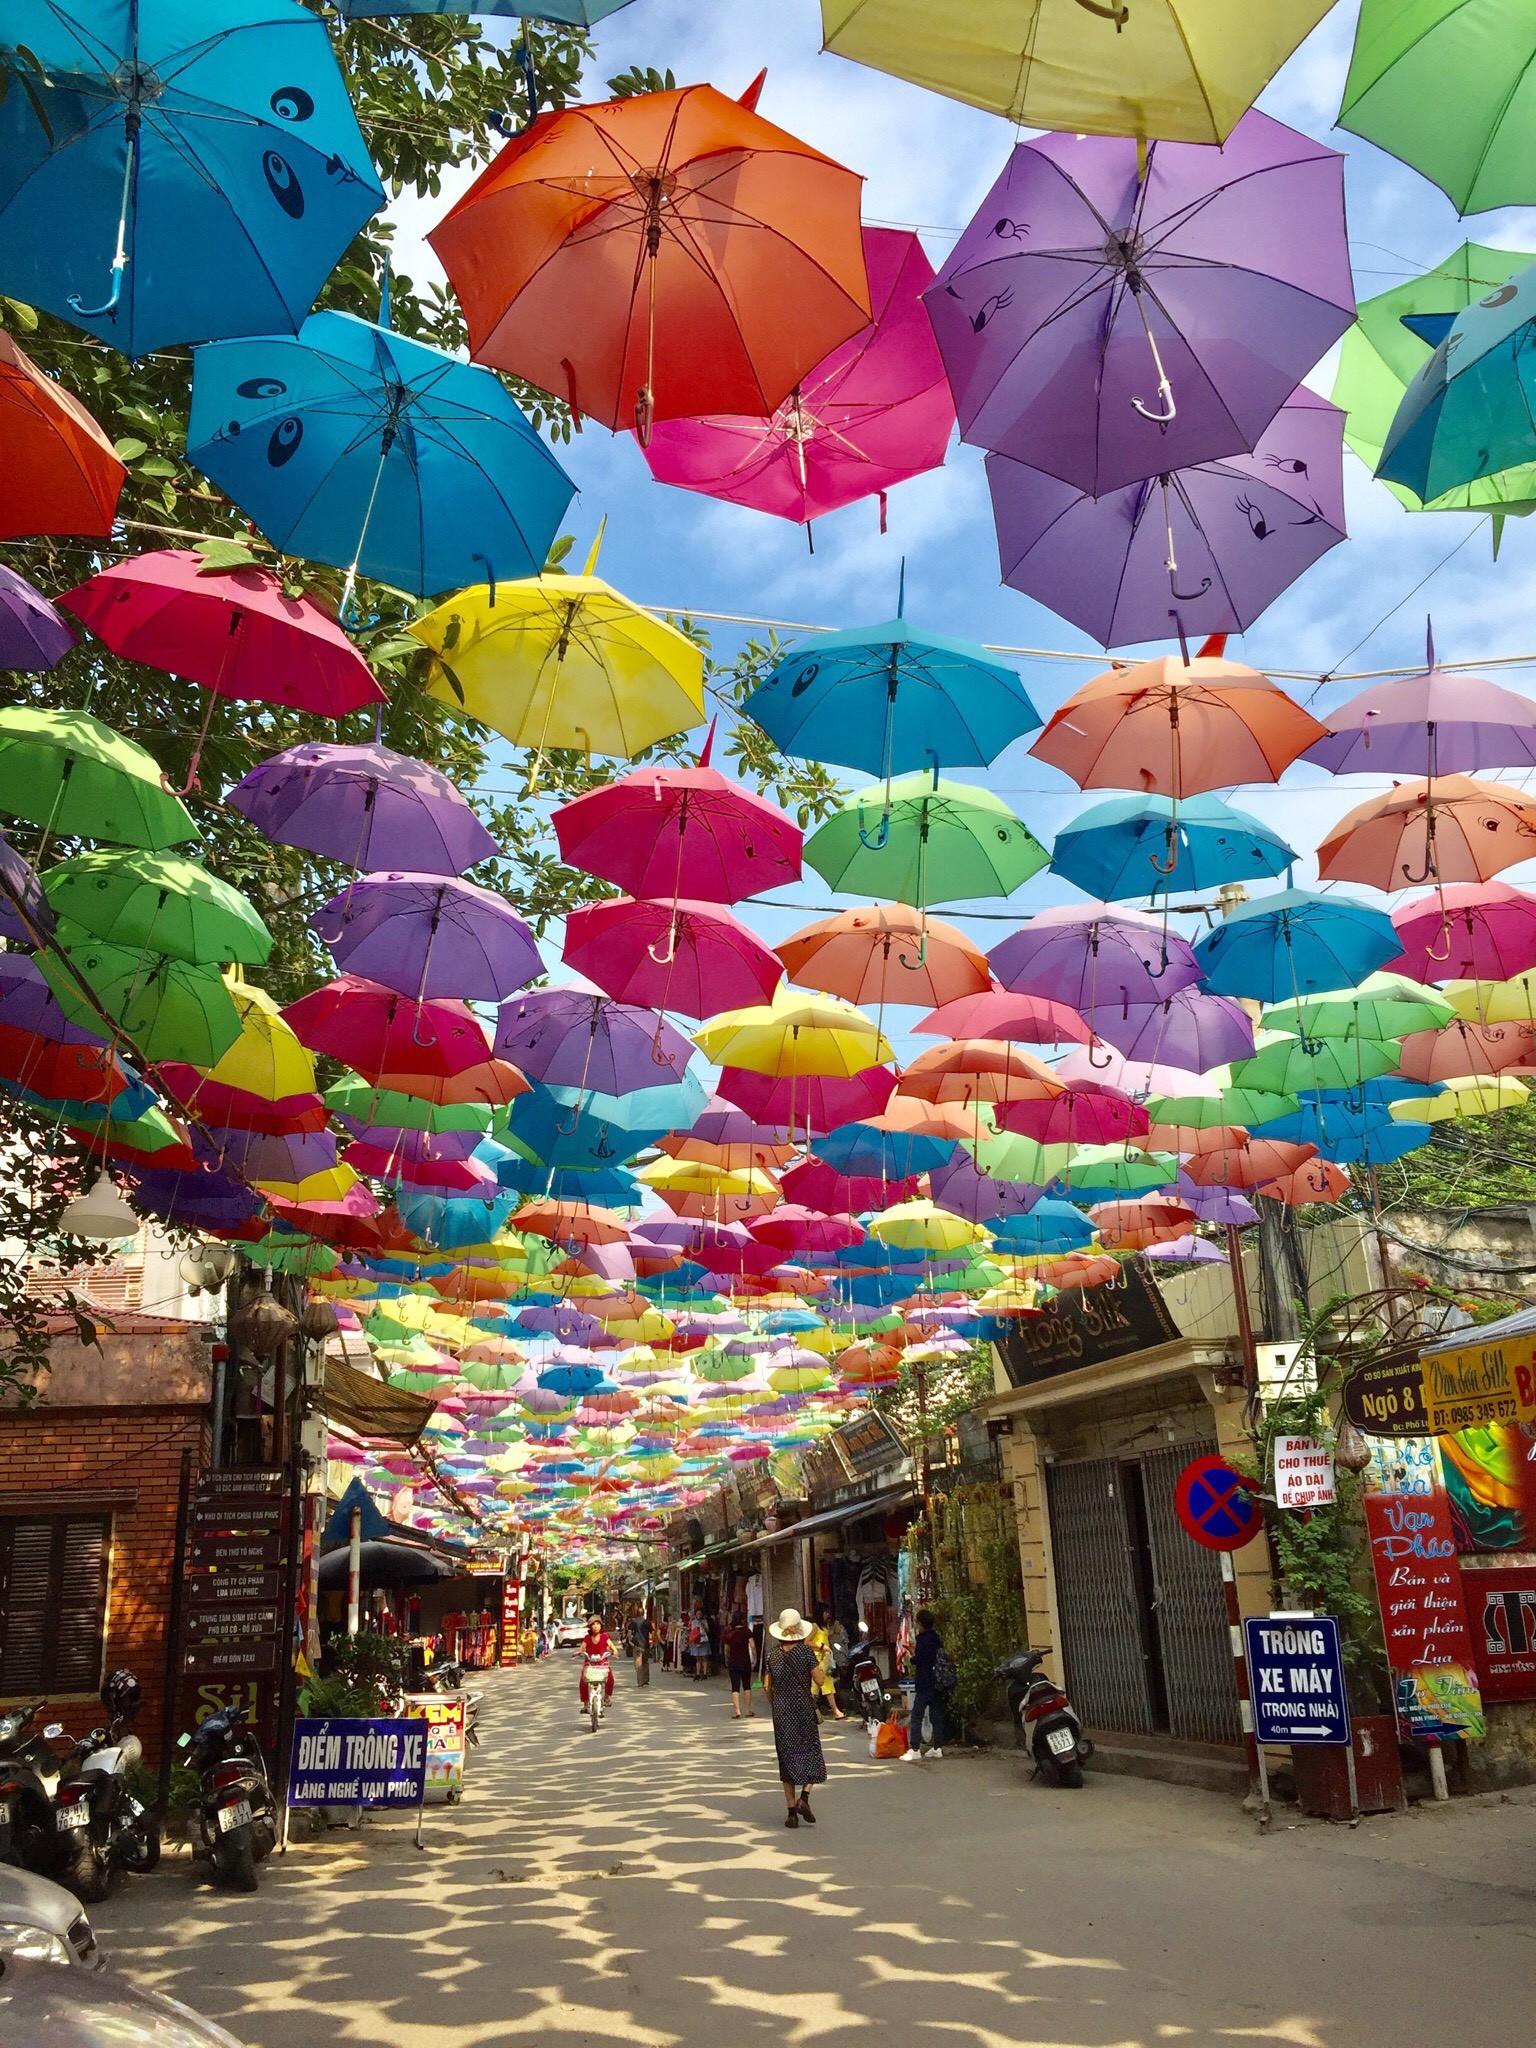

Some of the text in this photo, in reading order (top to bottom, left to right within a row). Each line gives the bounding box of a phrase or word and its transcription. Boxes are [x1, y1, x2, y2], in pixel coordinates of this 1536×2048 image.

[1481, 1349, 1510, 1391] Silk
[1361, 1387, 1398, 1422] Ngõ
[1403, 1386, 1415, 1412] 8
[1451, 1405, 1475, 1424] 0985
[1476, 1402, 1496, 1420] 345
[1497, 1399, 1517, 1418] 672
[1405, 1419, 1421, 1431] Phố
[1286, 1437, 1310, 1452] BÁN
[1278, 1452, 1331, 1470] CHO THUÊ
[1288, 1472, 1325, 1488] ÁO DÀI
[1380, 1473, 1432, 1500] Lụa
[1383, 1500, 1435, 1533] Vạn
[1389, 1566, 1451, 1587] Bán và
[1389, 1591, 1458, 1617] giới thiệu
[1258, 1625, 1326, 1655] TRÔNG
[1391, 1616, 1464, 1640] sản phẩm
[1411, 1643, 1453, 1667] Lụa
[1258, 1663, 1333, 1694] XE MÁY
[1488, 1663, 1512, 1674] MINH
[408, 1704, 462, 1723] KEM
[1261, 1699, 1339, 1720] (TRONG NHÀ)
[1270, 1725, 1289, 1734] 40m
[298, 1721, 423, 1770] ĐIỂM TRÔNG XE
[295, 1776, 418, 1802] LÀNG NGHỀ VẠN PHÚC
